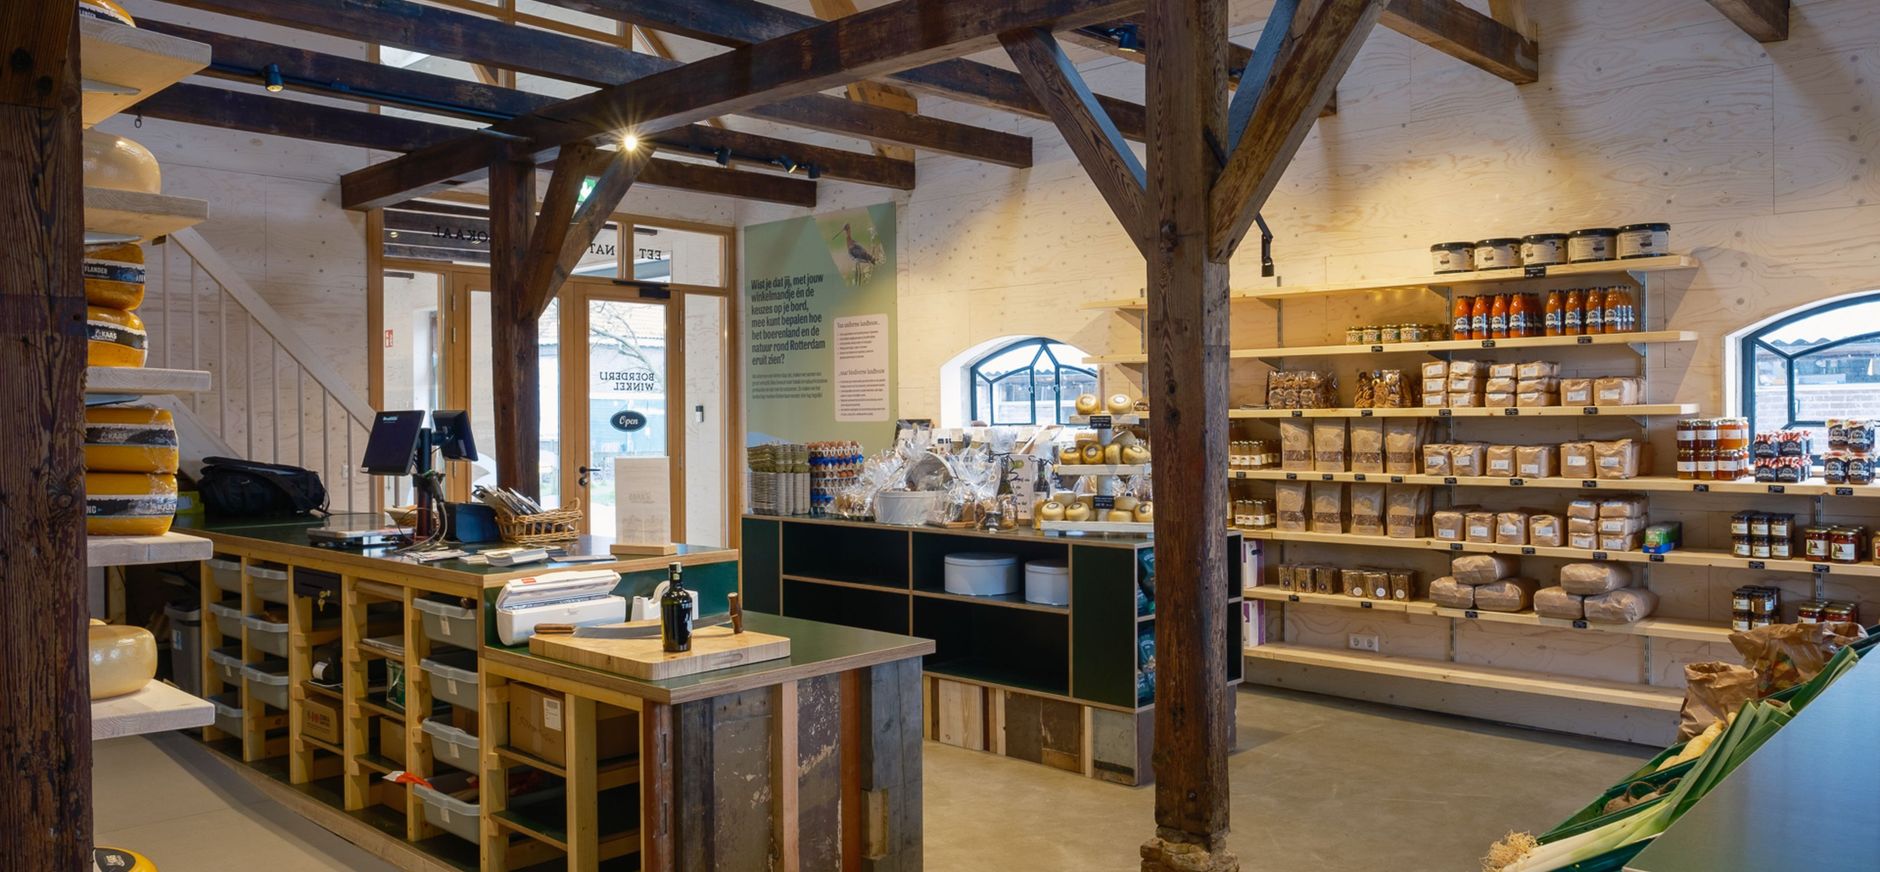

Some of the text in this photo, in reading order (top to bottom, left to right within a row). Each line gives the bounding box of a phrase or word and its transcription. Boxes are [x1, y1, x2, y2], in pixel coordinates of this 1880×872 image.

[751, 279, 765, 290] Wist
[766, 279, 772, 291] je
[773, 277, 783, 288] dat
[793, 275, 806, 285] met
[807, 274, 823, 286] jouw
[751, 289, 795, 302] winkelmandje
[806, 287, 814, 297] de
[751, 300, 808, 315] keuzes op je bord,
[752, 313, 822, 328] mee kunt bepalen hoe
[752, 325, 819, 340] het boerenland en de
[752, 339, 825, 352] natuur rond Rotterdam
[752, 354, 785, 365] eruit zien?
[619, 415, 639, 428] Open
